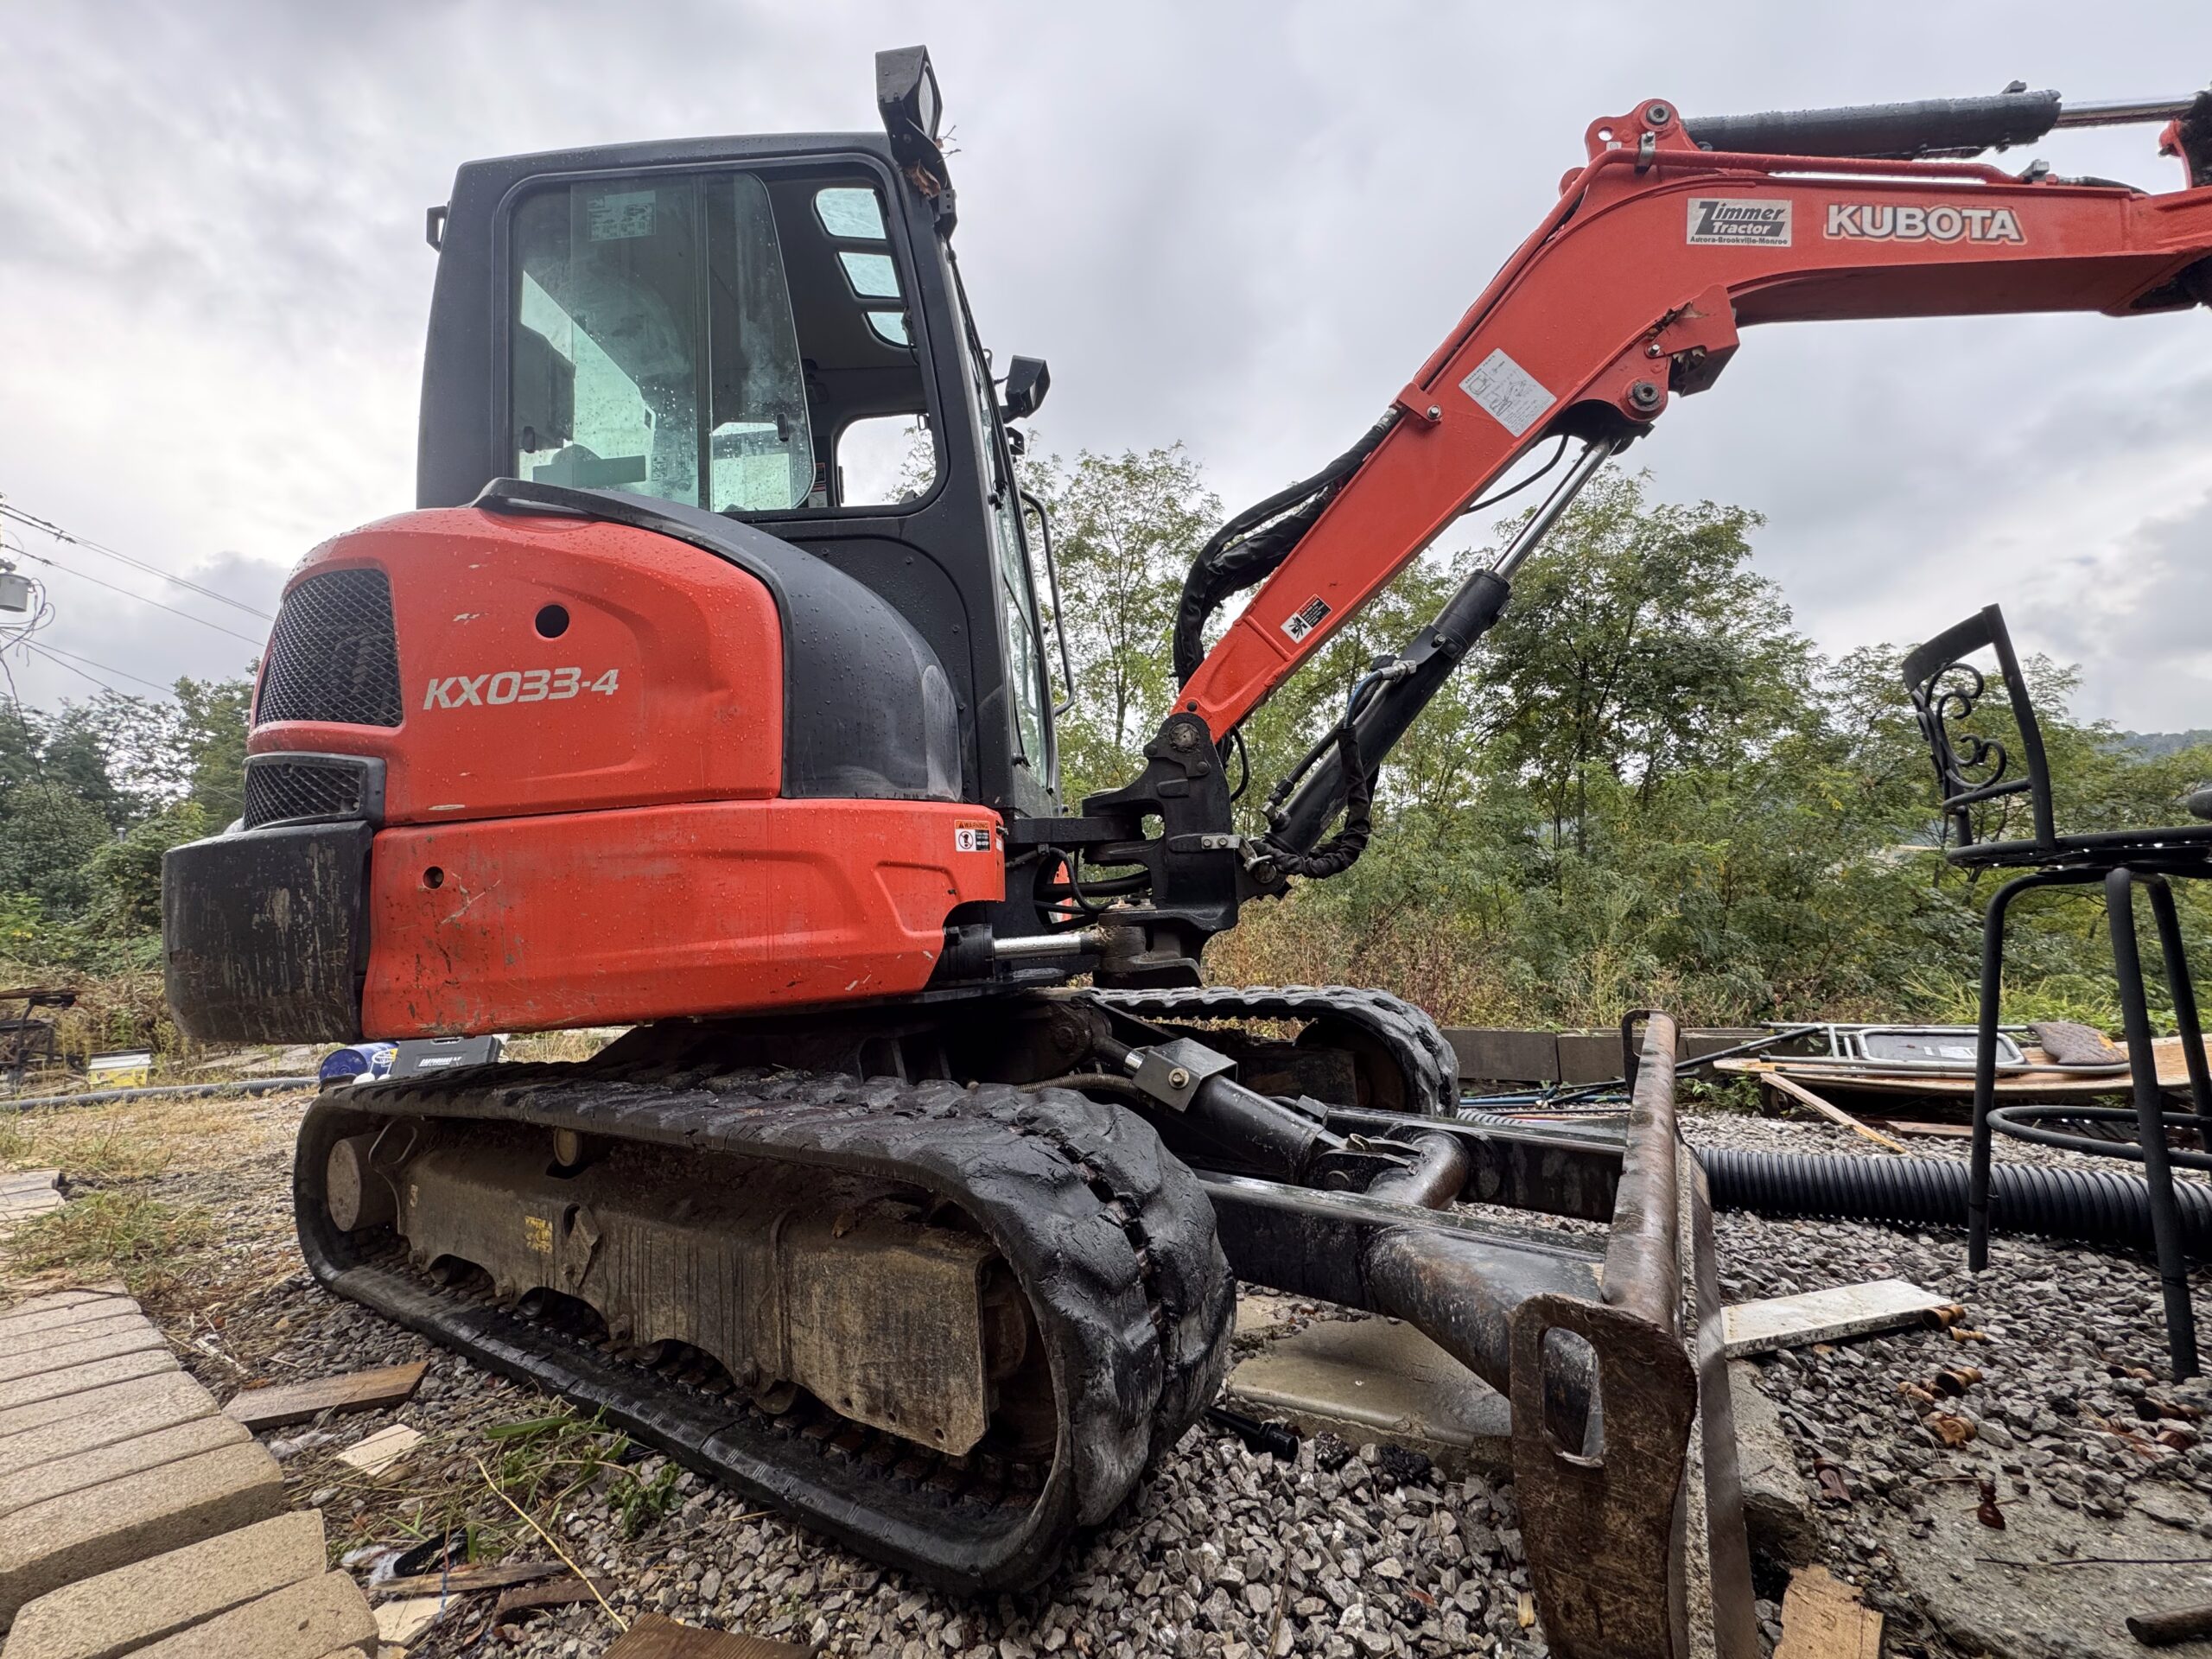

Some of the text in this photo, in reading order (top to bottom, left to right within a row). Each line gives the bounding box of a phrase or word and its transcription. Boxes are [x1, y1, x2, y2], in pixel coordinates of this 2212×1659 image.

[1694, 200, 1786, 236] Zimmer
[1712, 221, 1771, 235] Tractor
[1827, 204, 2024, 242] KUBOTA
[423, 666, 620, 710] KX033-4
